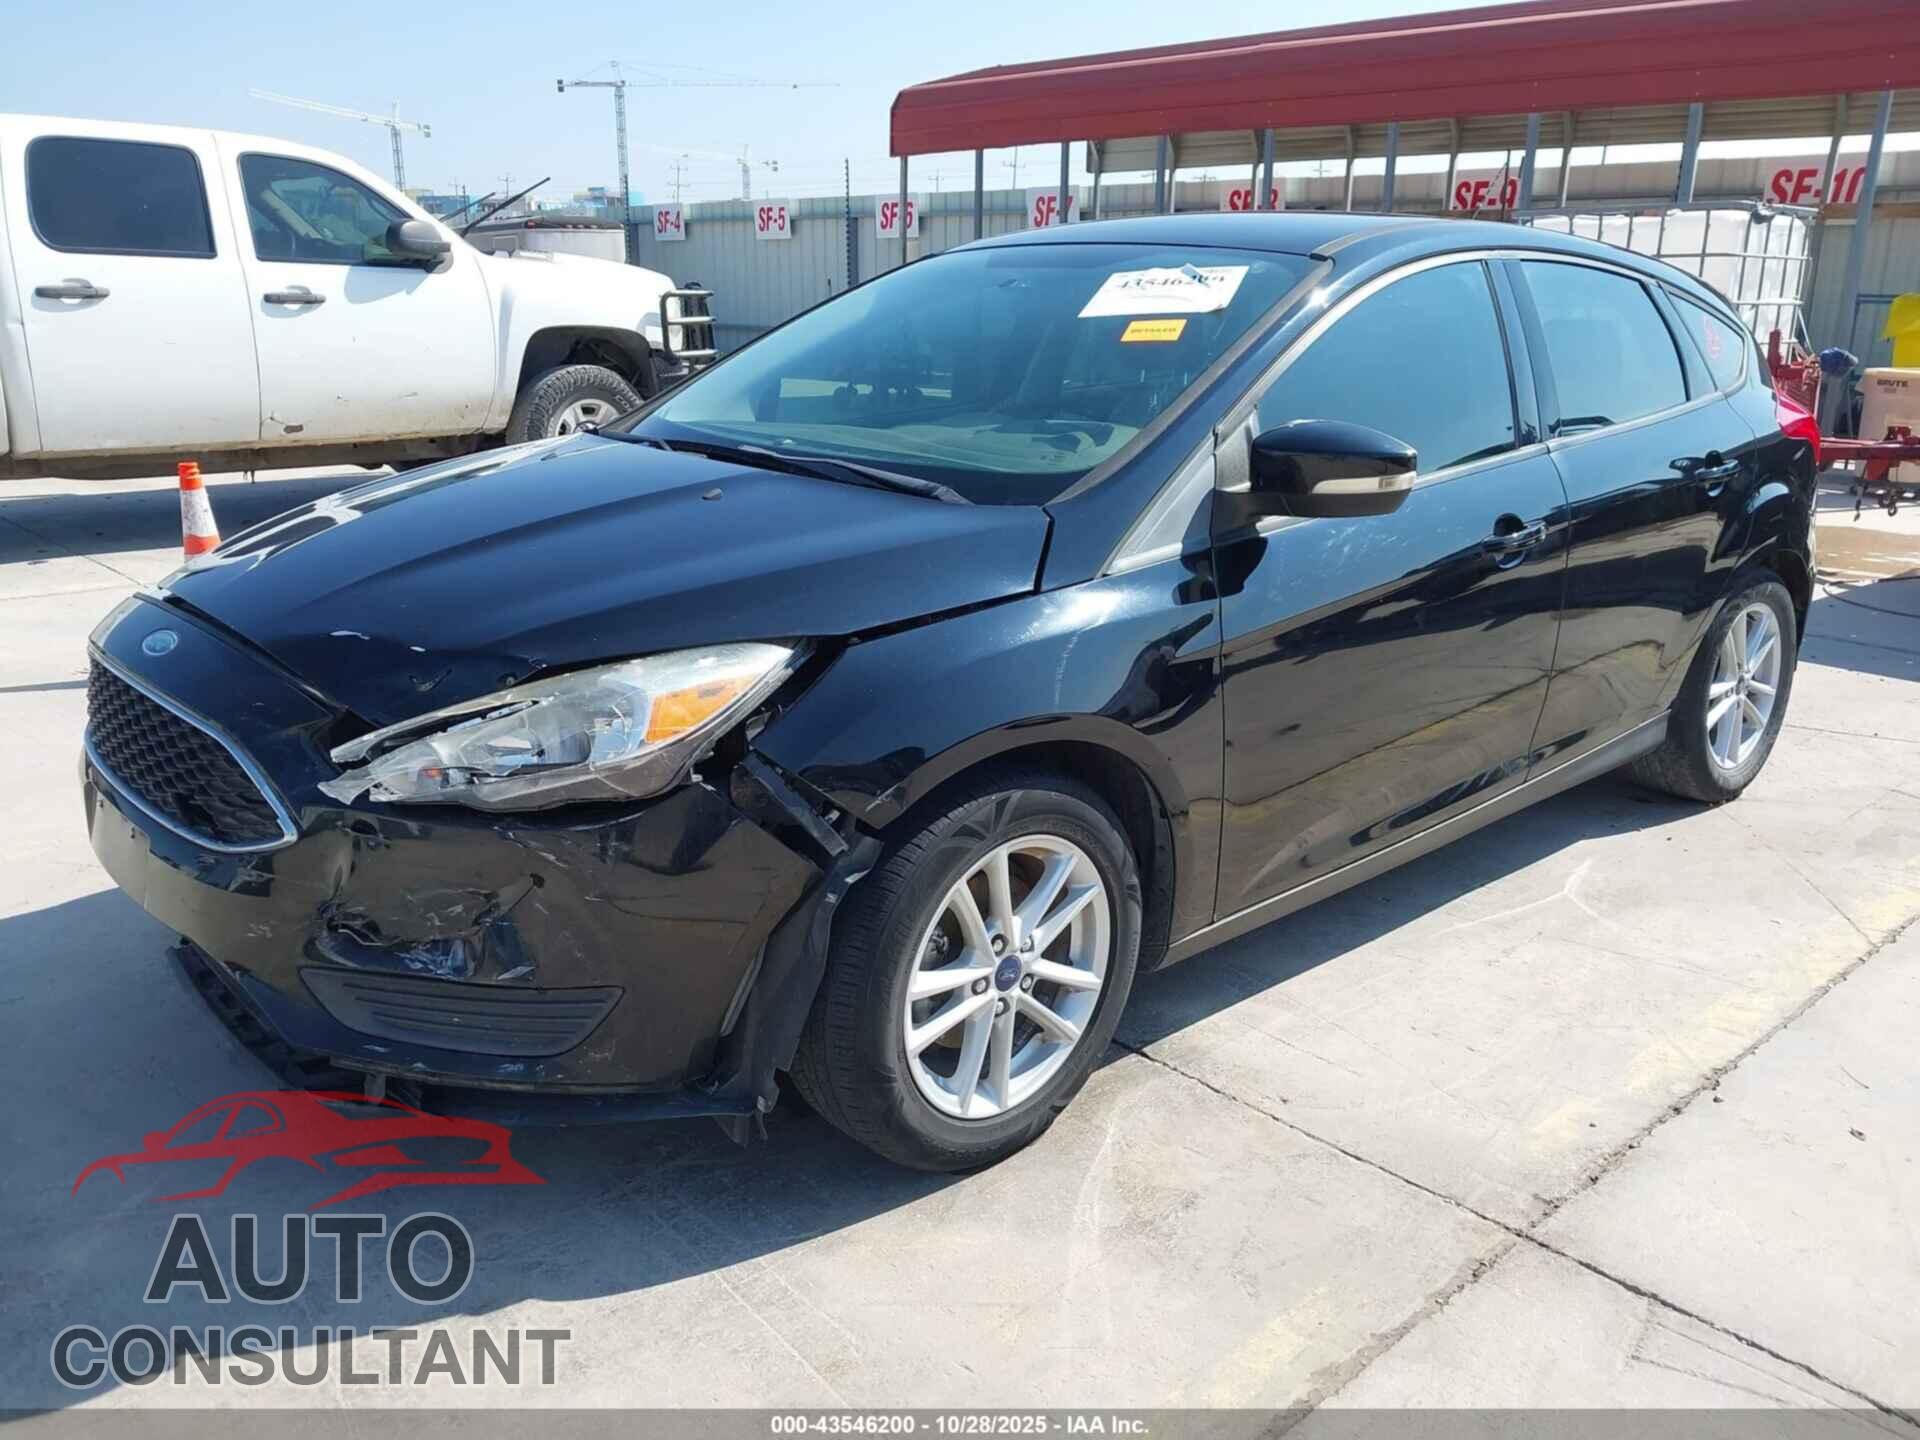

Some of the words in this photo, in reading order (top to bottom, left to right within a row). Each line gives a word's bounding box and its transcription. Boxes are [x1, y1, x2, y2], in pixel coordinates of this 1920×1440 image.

[657, 210, 681, 233] SF-4
[758, 206, 786, 232] SF-5
[880, 202, 914, 230] SF6
